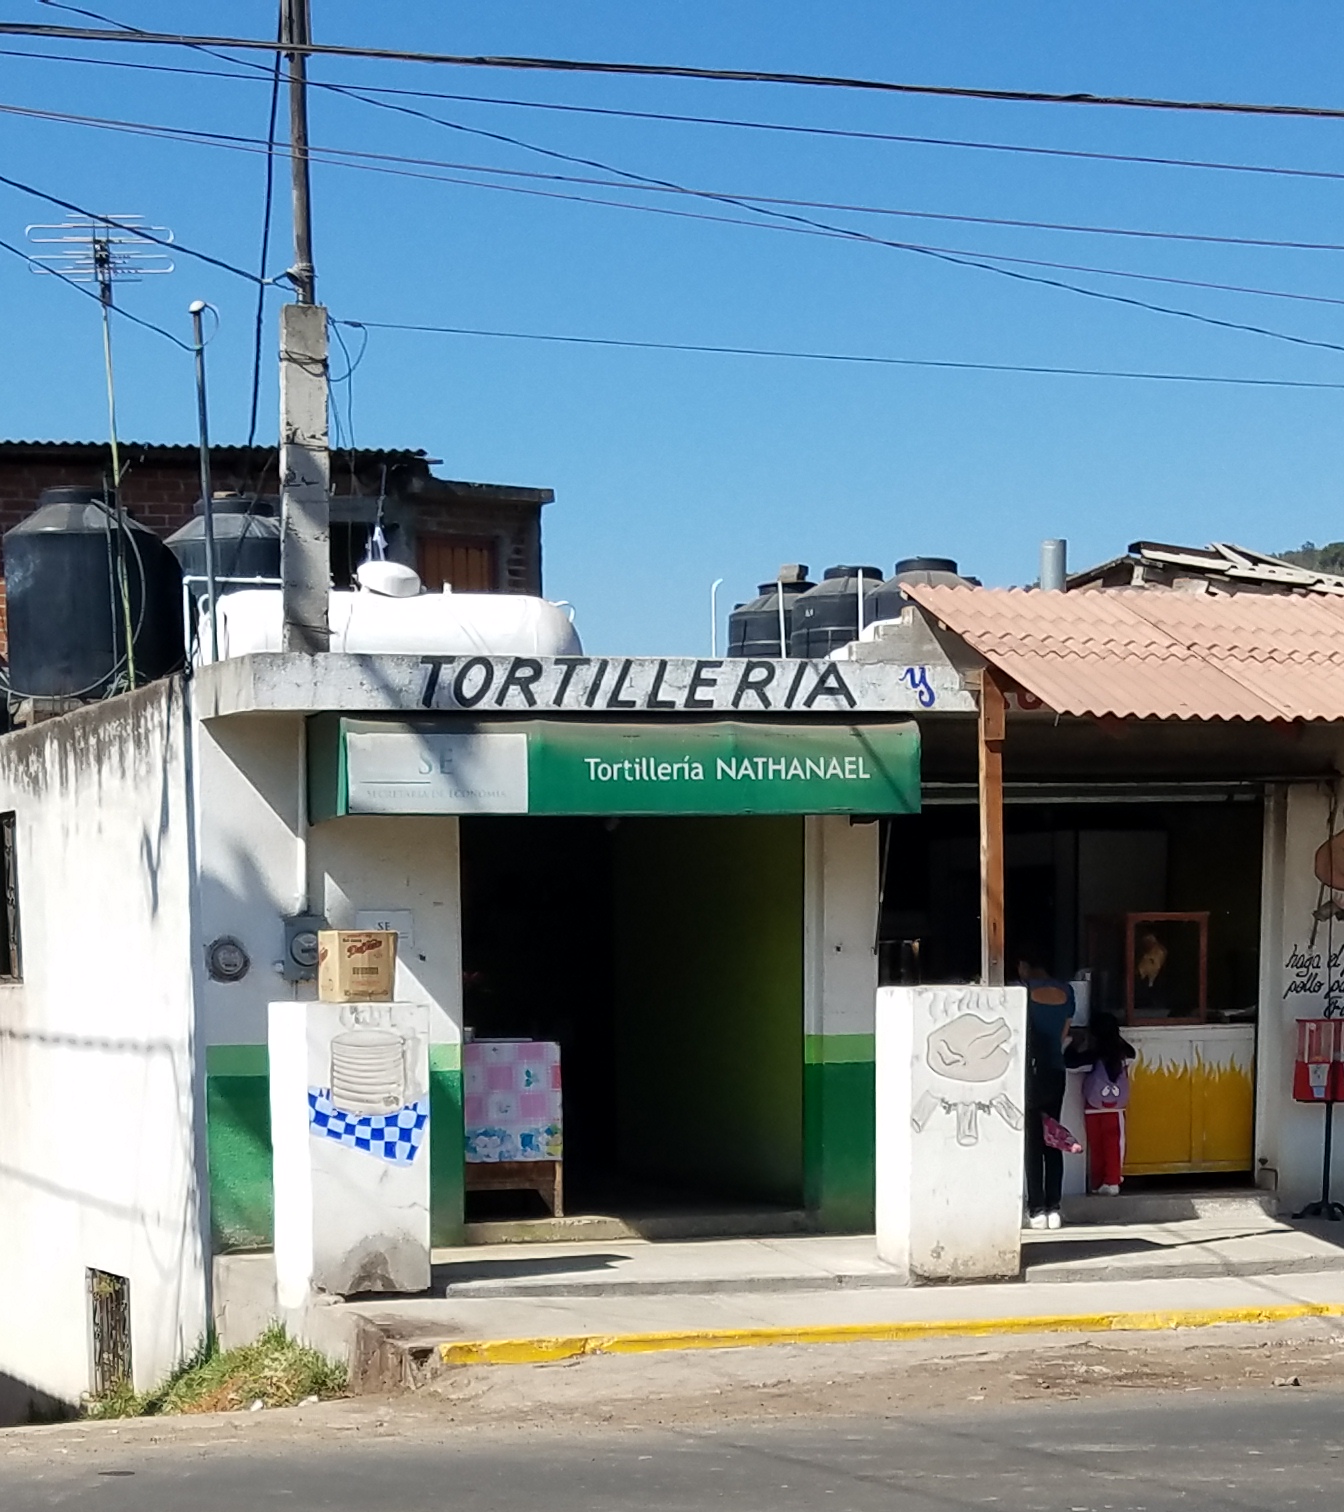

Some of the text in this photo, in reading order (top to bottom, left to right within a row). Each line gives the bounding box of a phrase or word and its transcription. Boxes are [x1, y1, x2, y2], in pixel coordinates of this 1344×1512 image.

[420, 656, 936, 709] TORTILLERIA y
[418, 749, 454, 775] SE
[584, 755, 871, 781] Tortillería NATHANAEL
[1285, 944, 1321, 978] haga
[1282, 973, 1325, 999] pollo
